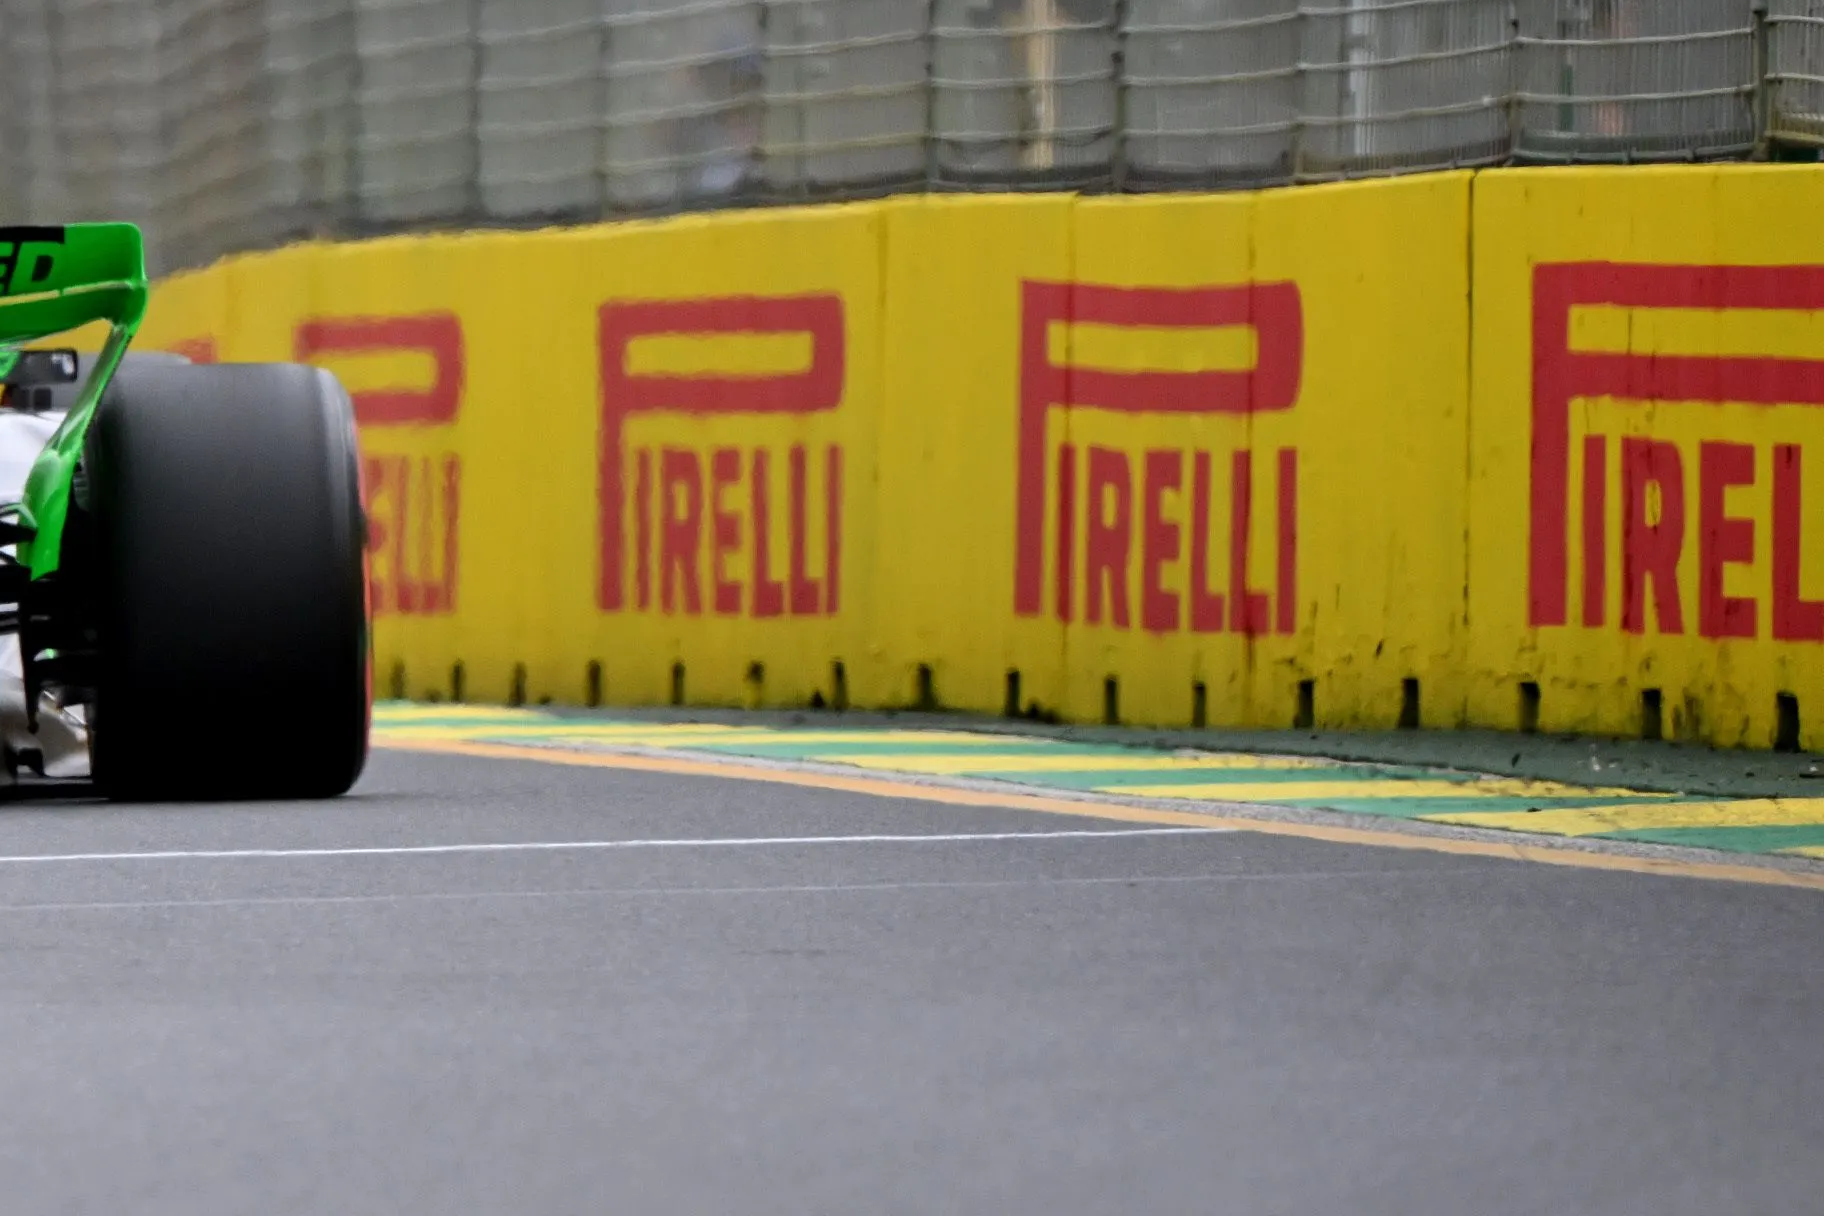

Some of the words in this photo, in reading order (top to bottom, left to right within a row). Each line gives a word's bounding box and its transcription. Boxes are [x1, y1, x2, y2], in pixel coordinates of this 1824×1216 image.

[594, 291, 846, 618] PIRELLI
[1013, 278, 1304, 636] PIRELLI
[1529, 261, 1824, 642] PIREL
